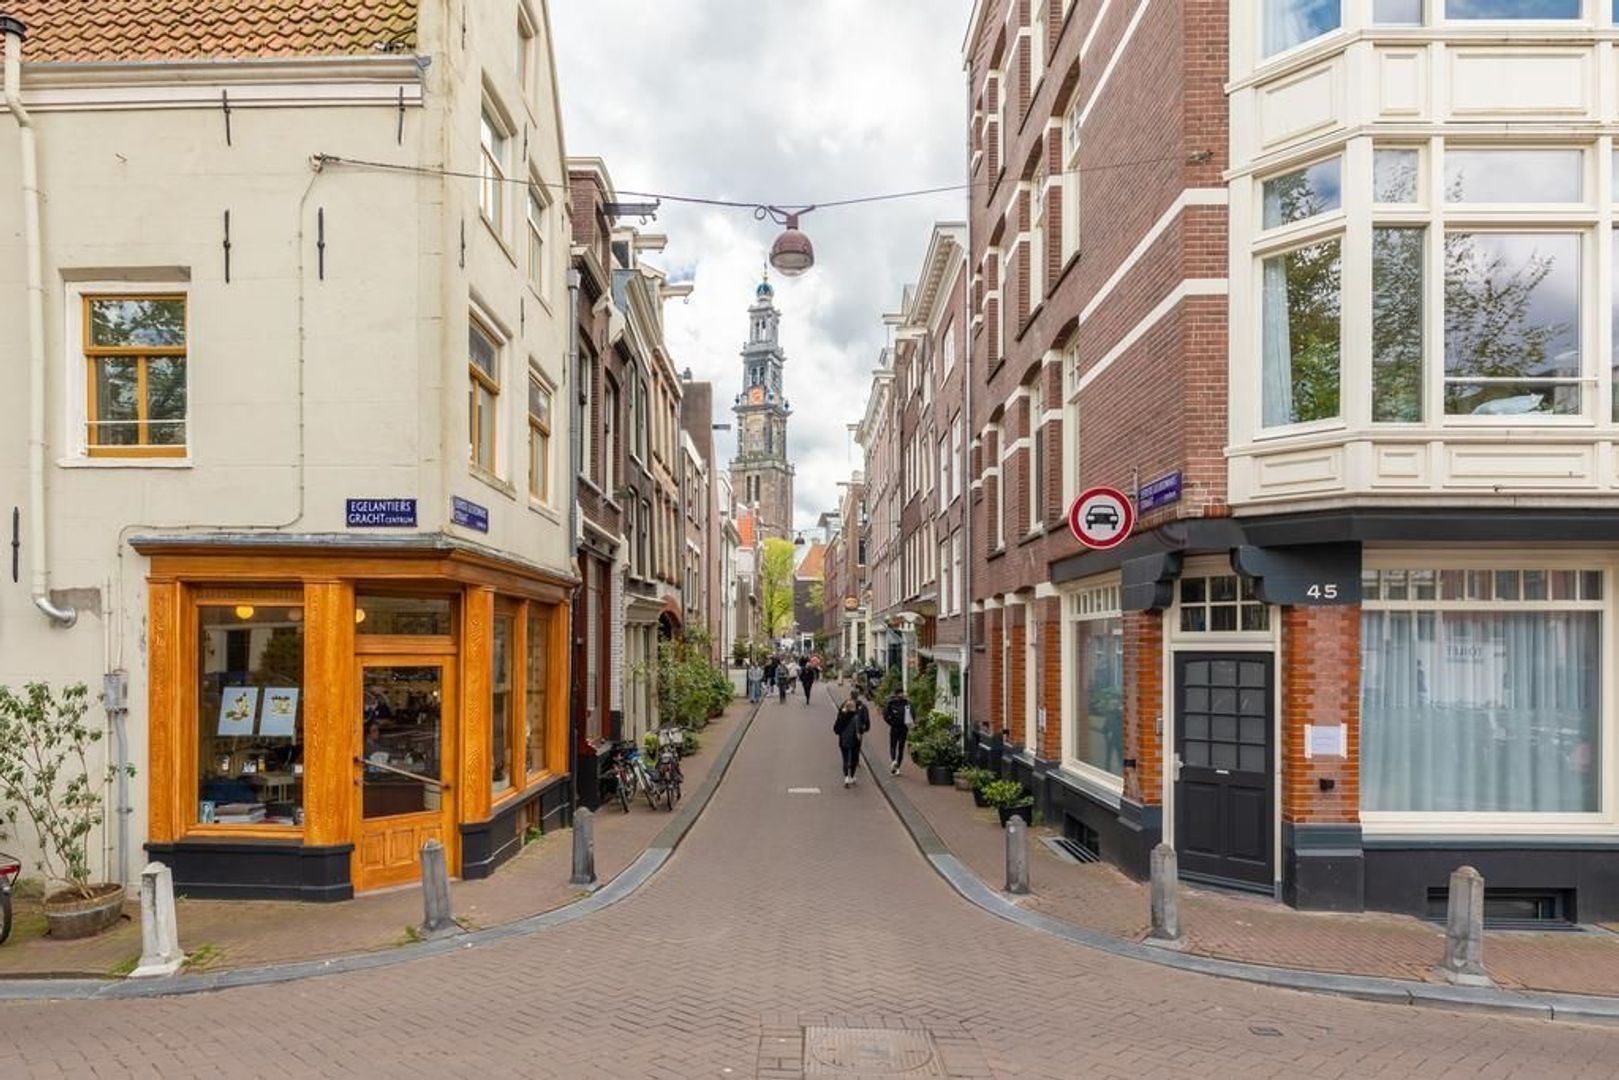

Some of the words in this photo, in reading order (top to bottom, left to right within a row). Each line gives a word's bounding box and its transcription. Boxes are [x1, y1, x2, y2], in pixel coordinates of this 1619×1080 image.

[351, 501, 411, 512] EGELANTIERS
[348, 513, 385, 524] GRACHT
[385, 516, 414, 524] CENTRUM
[1306, 583, 1338, 599] 45
